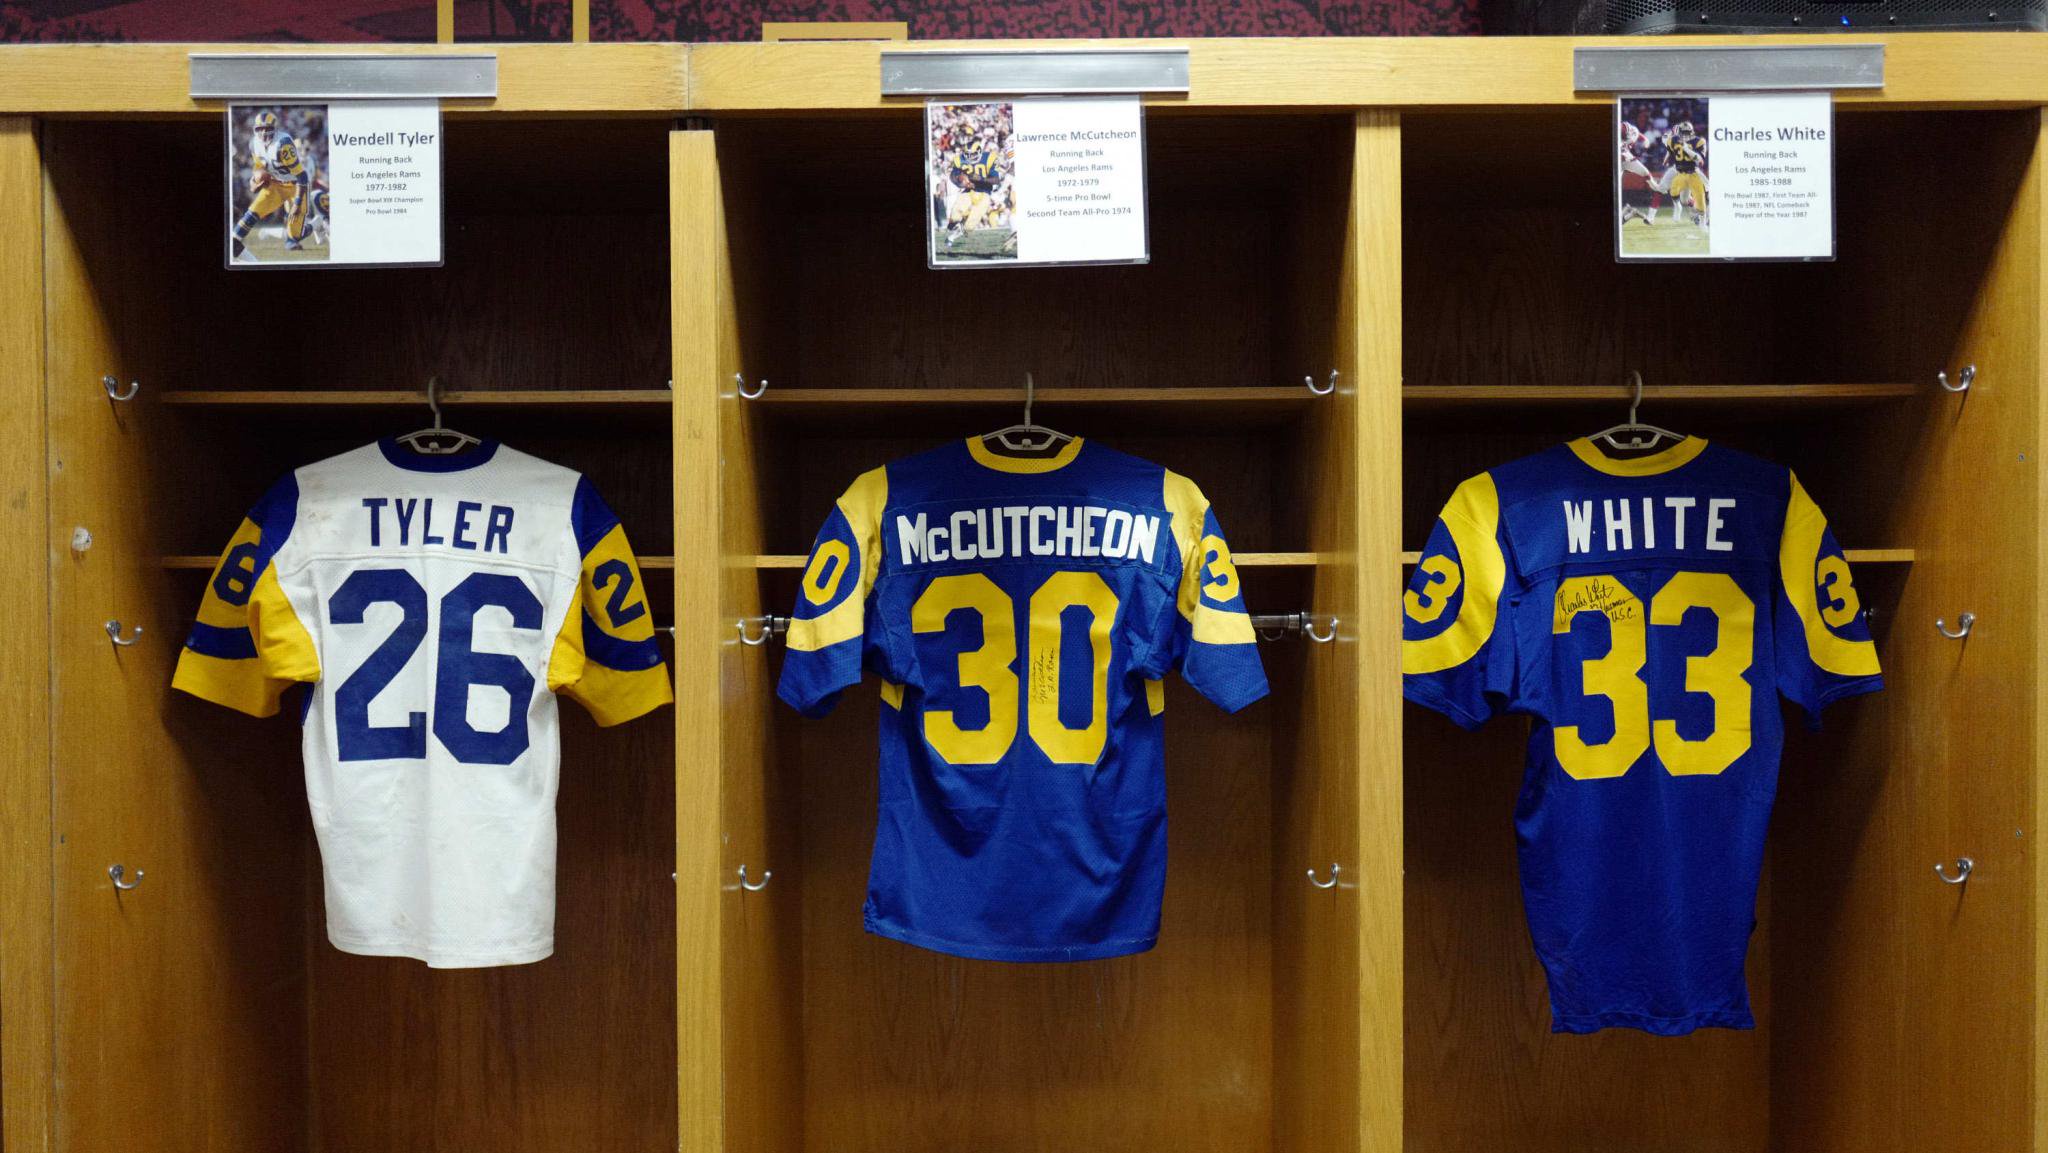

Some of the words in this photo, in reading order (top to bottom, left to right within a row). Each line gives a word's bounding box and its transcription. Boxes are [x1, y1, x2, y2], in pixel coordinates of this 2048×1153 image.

[333, 132, 394, 146] Wendell
[398, 132, 434, 148] Tyler
[1016, 133, 1067, 142] Lawrence
[1070, 130, 1137, 140] McCutcheon
[1714, 127, 1772, 141] Charles
[1777, 126, 1826, 140] White
[360, 156, 392, 165] Running
[394, 155, 412, 164] Back
[1050, 150, 1083, 158] Running
[1086, 148, 1104, 156] Back
[1744, 151, 1776, 160] Running
[1779, 150, 1798, 158] Back
[366, 171, 397, 180] Angeles
[400, 170, 421, 178] Rams
[1058, 164, 1088, 173] Angeles
[1736, 166, 1748, 174] Los
[1750, 166, 1782, 174] Angeles
[1784, 165, 1806, 173] Rams
[366, 184, 407, 192] 1977-1982
[1058, 178, 1100, 187] 1972-1979
[1750, 178, 1792, 186] 1985-1988
[1046, 194, 1072, 202] 5-time
[1090, 192, 1111, 200] Bowl
[1027, 209, 1056, 218] Second
[1059, 208, 1080, 216] Team
[1082, 208, 1110, 216] All-Pro
[1112, 207, 1132, 215] 1974
[362, 498, 515, 554] TYLER
[1564, 497, 1736, 554] WHITE
[896, 506, 1160, 566] McCUTCHEON
[212, 542, 262, 606] 6
[802, 539, 850, 606] 0
[1199, 534, 1240, 602] 3
[592, 559, 646, 629] 2
[1403, 554, 1462, 624] 3
[1818, 555, 1861, 629] 3
[328, 568, 544, 766] 26
[911, 571, 1120, 765] 30
[1553, 571, 1756, 781] 33
